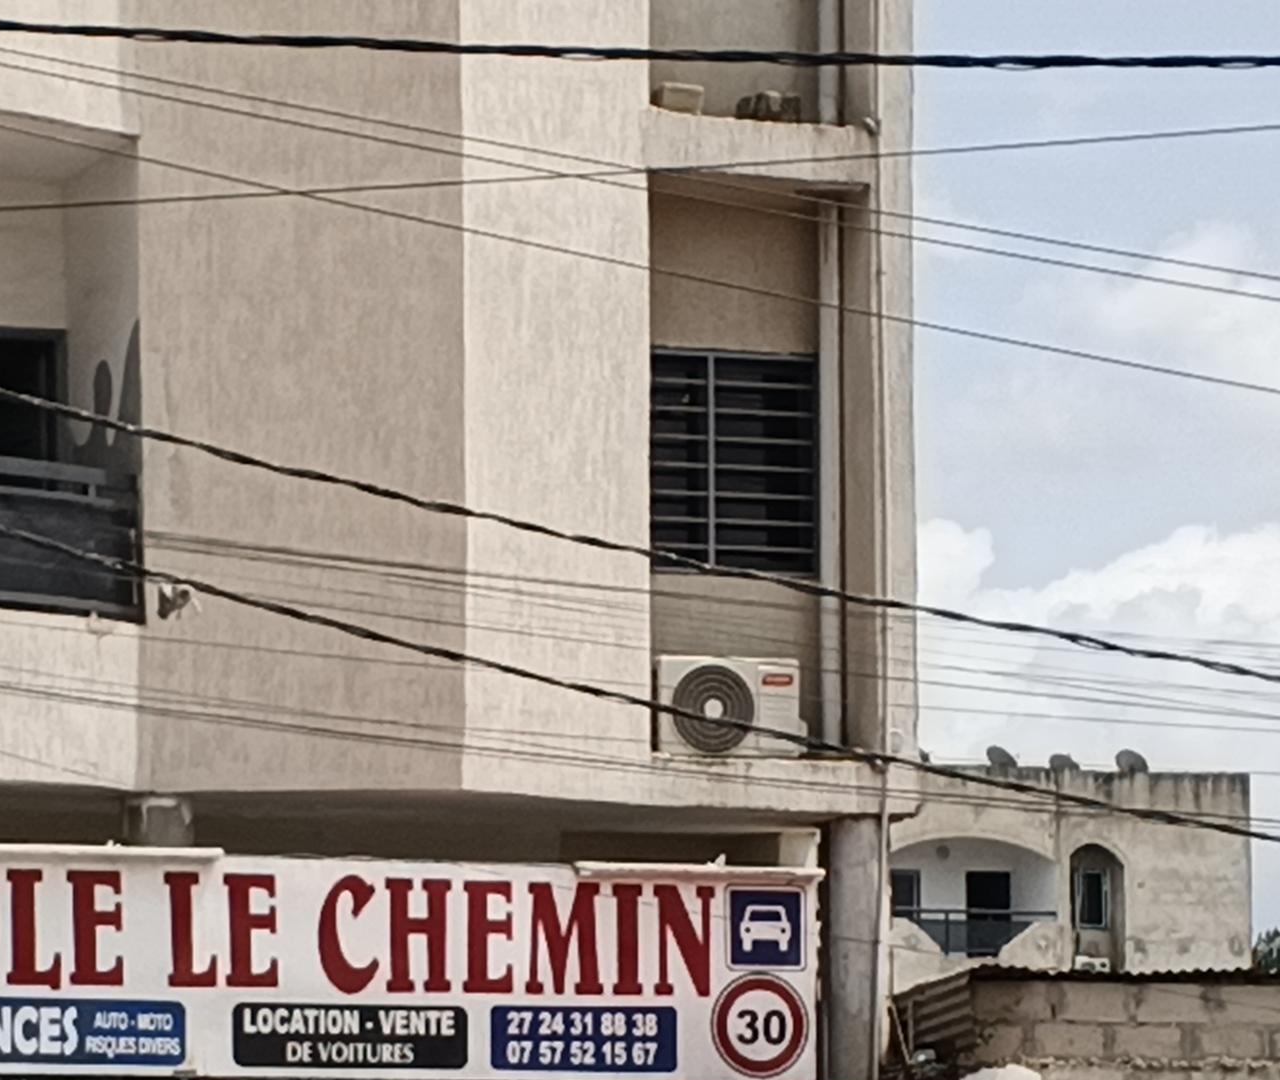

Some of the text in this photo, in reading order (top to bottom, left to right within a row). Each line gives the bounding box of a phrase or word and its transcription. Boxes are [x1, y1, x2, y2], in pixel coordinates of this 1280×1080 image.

[164, 872, 278, 987] LE
[318, 875, 714, 997] CHEMIN
[93, 1010, 174, 1032] AUTO MOTO
[242, 1007, 456, 1036] LOCATION VENTE
[506, 1011, 658, 1037] 27 24 31 88 38
[736, 1009, 787, 1046] 30
[85, 1035, 181, 1058] RISQUES DIVERS
[285, 1040, 415, 1065] DE VOITURES
[506, 1041, 658, 1066] 07 57 52 15 67
